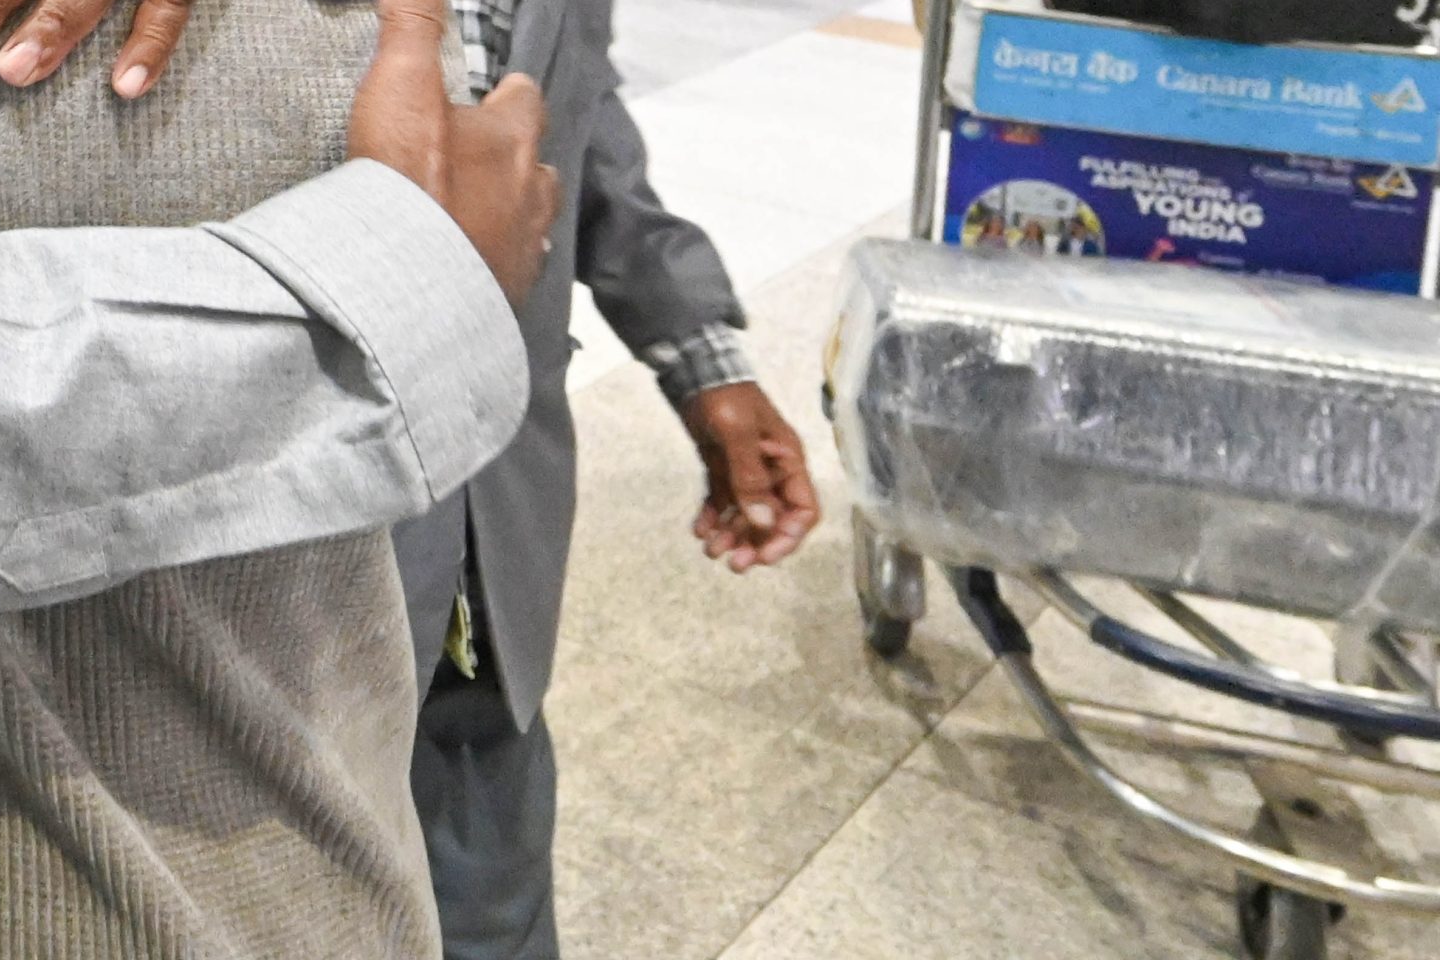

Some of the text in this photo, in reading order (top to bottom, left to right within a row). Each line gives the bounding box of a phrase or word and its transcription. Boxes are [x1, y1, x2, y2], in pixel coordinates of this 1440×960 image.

[1157, 62, 1271, 101] Canara
[1281, 75, 1363, 109] Bank
[1133, 190, 1264, 228] YOUNG
[1167, 217, 1247, 244] INDIA
